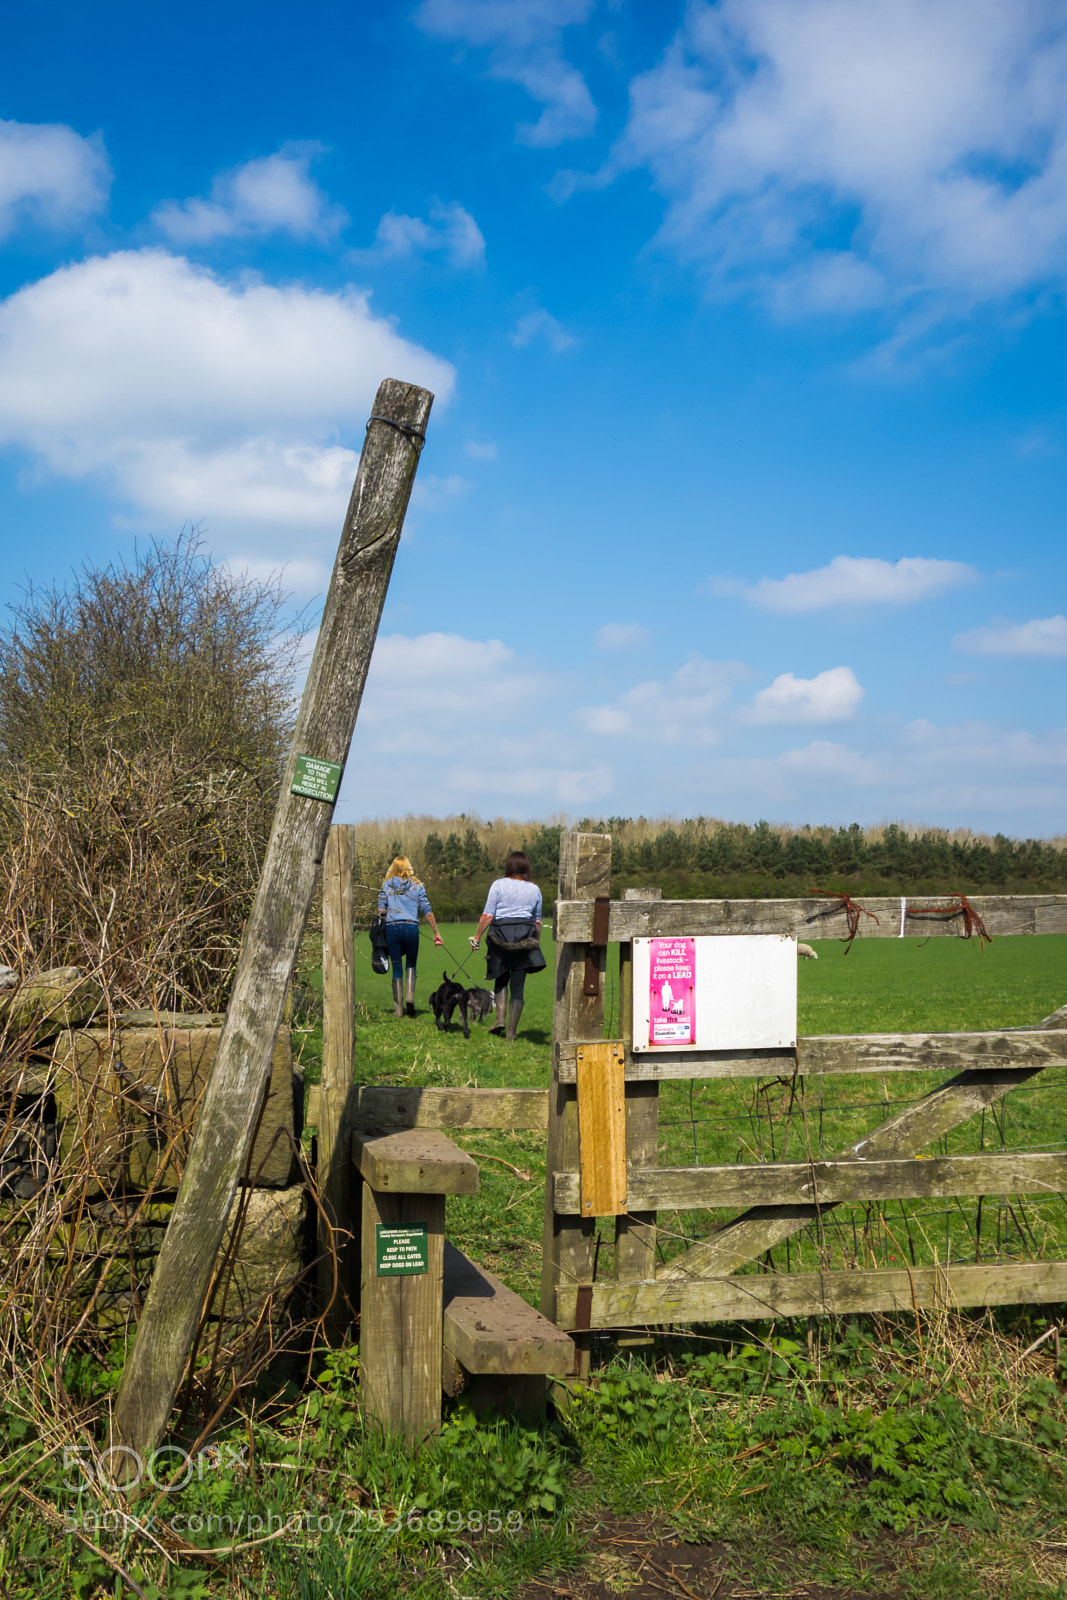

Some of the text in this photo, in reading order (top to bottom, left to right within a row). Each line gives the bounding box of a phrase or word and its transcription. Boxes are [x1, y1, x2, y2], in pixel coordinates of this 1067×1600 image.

[306, 762, 331, 774] DAMAGE
[302, 780, 320, 790] RESULT
[303, 774, 328, 786] SIGN WILL
[292, 784, 334, 800] PROSECUTION
[674, 941, 686, 949] dog
